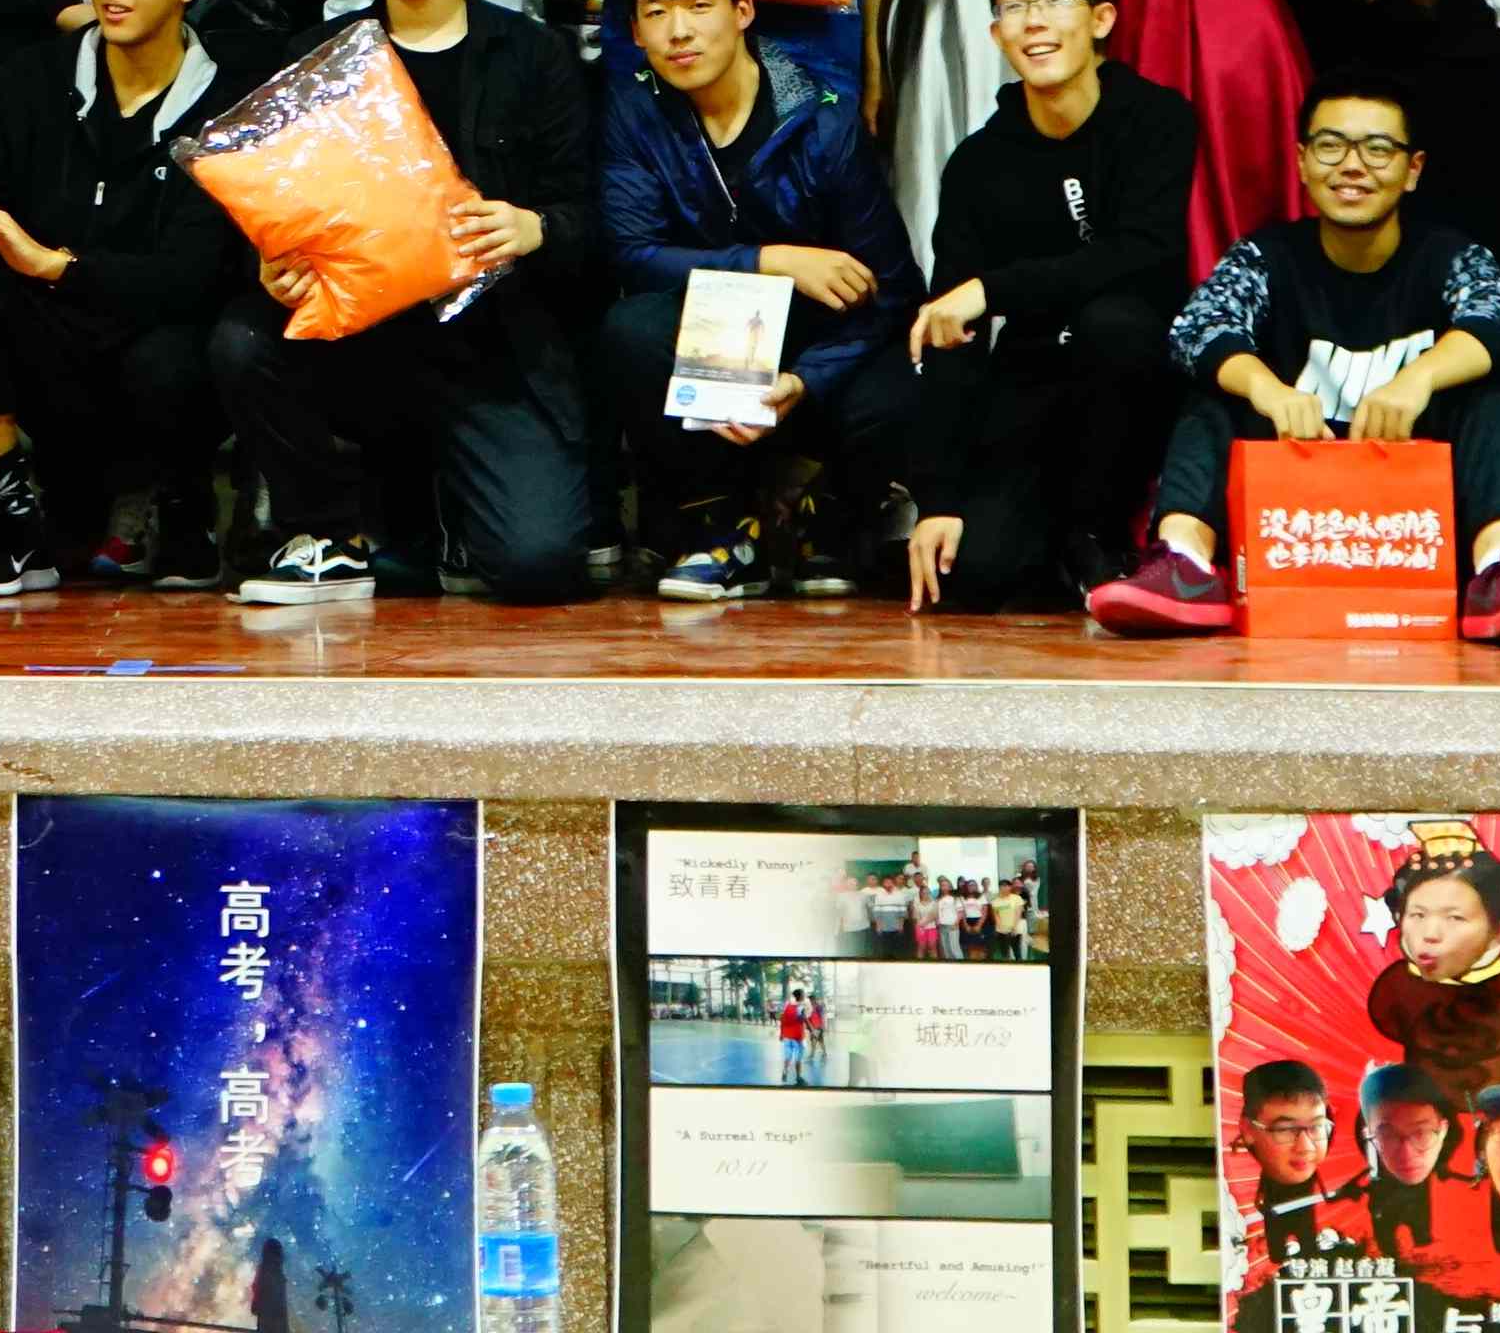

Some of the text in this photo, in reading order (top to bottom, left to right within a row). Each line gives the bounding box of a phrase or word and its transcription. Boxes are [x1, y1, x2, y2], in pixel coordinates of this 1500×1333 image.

[669, 873, 750, 899] 致青春
[939, 1261, 964, 1271] and
